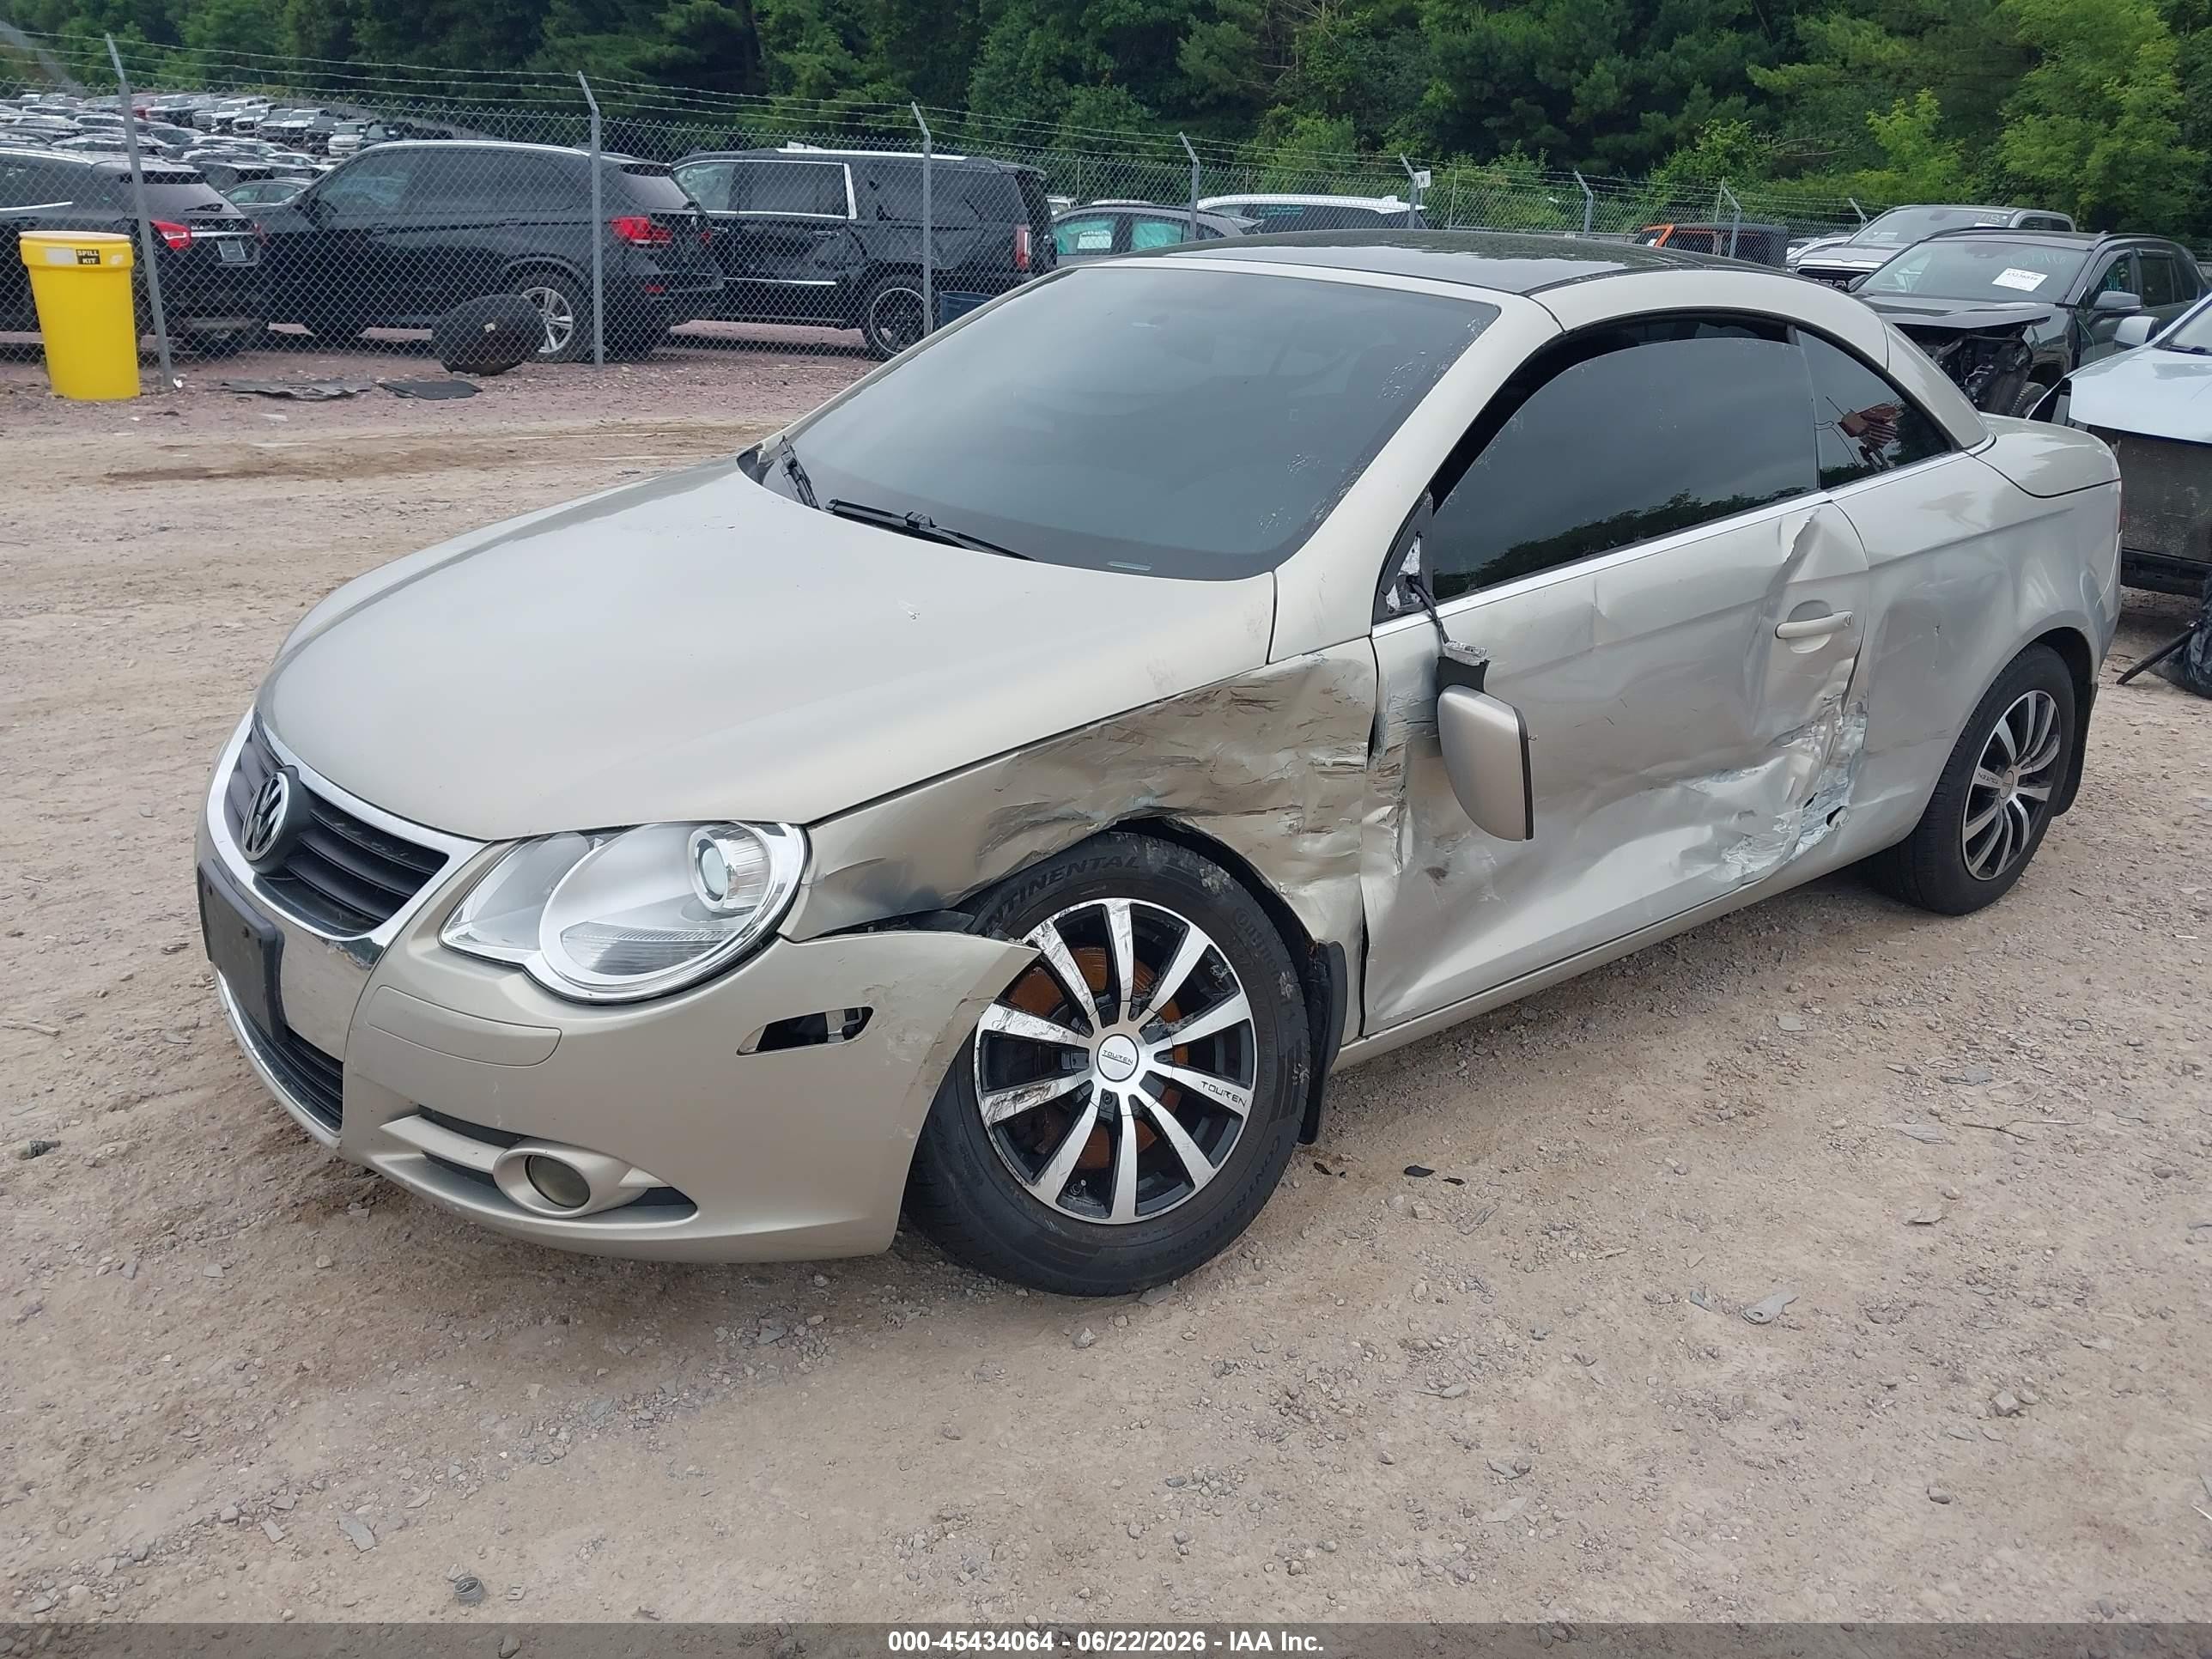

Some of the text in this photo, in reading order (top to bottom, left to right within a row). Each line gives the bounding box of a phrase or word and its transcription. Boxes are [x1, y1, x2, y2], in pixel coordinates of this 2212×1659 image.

[984, 855, 1142, 933] NTINENTAL
[1103, 1049, 1134, 1065] TOUREN
[1201, 1080, 1248, 1109] TOUREN
